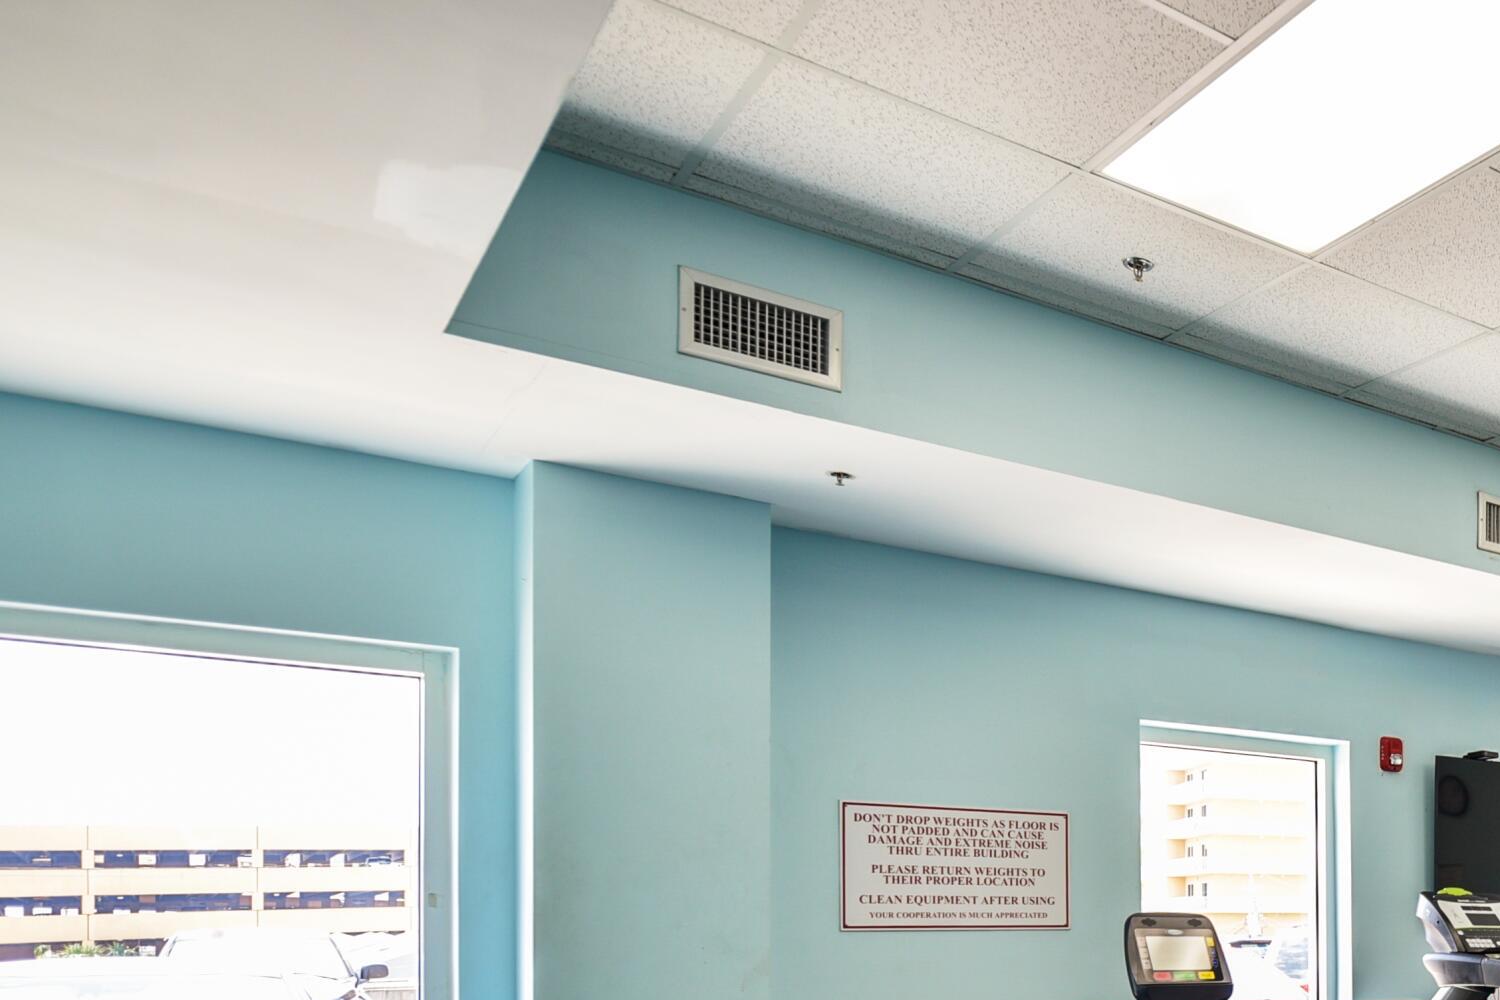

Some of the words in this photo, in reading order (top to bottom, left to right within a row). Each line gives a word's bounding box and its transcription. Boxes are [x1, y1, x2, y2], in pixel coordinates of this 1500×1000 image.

[854, 812, 893, 823] DON'T
[896, 815, 931, 825] DROP
[932, 816, 989, 828] WEIGHTS
[991, 820, 1006, 829] AS
[1008, 820, 1047, 831] FLOOR
[1050, 822, 1060, 831] IS
[872, 824, 899, 834] NOT
[902, 825, 950, 836] PADDED
[953, 828, 978, 838] AND
[980, 829, 1005, 839] CAN
[1007, 830, 1045, 840] CAUSE
[867, 834, 923, 846] DAMAGE
[927, 837, 952, 847] AND
[955, 838, 1012, 849] EXTREME
[1014, 840, 1048, 850] NOISE
[887, 845, 922, 856] THRU
[926, 847, 970, 857] ENTIRE
[973, 848, 1029, 859] BUILDING
[871, 864, 919, 875] PLEASE
[922, 865, 971, 875] RETURN
[974, 866, 1028, 877] WEIGHTS
[1030, 868, 1046, 877] TO
[883, 874, 922, 885] THEIR
[926, 875, 973, 886] PROPER
[976, 877, 1035, 887] LOCATION
[858, 894, 903, 905] CLEAN
[906, 895, 978, 906] EQUIPMENT
[981, 896, 1019, 905] AFTER
[1022, 896, 1055, 905] USING
[869, 911, 894, 919] YOUR
[896, 911, 957, 919] COOPERATION
[959, 911, 967, 919] IS
[968, 911, 993, 919] MUCH
